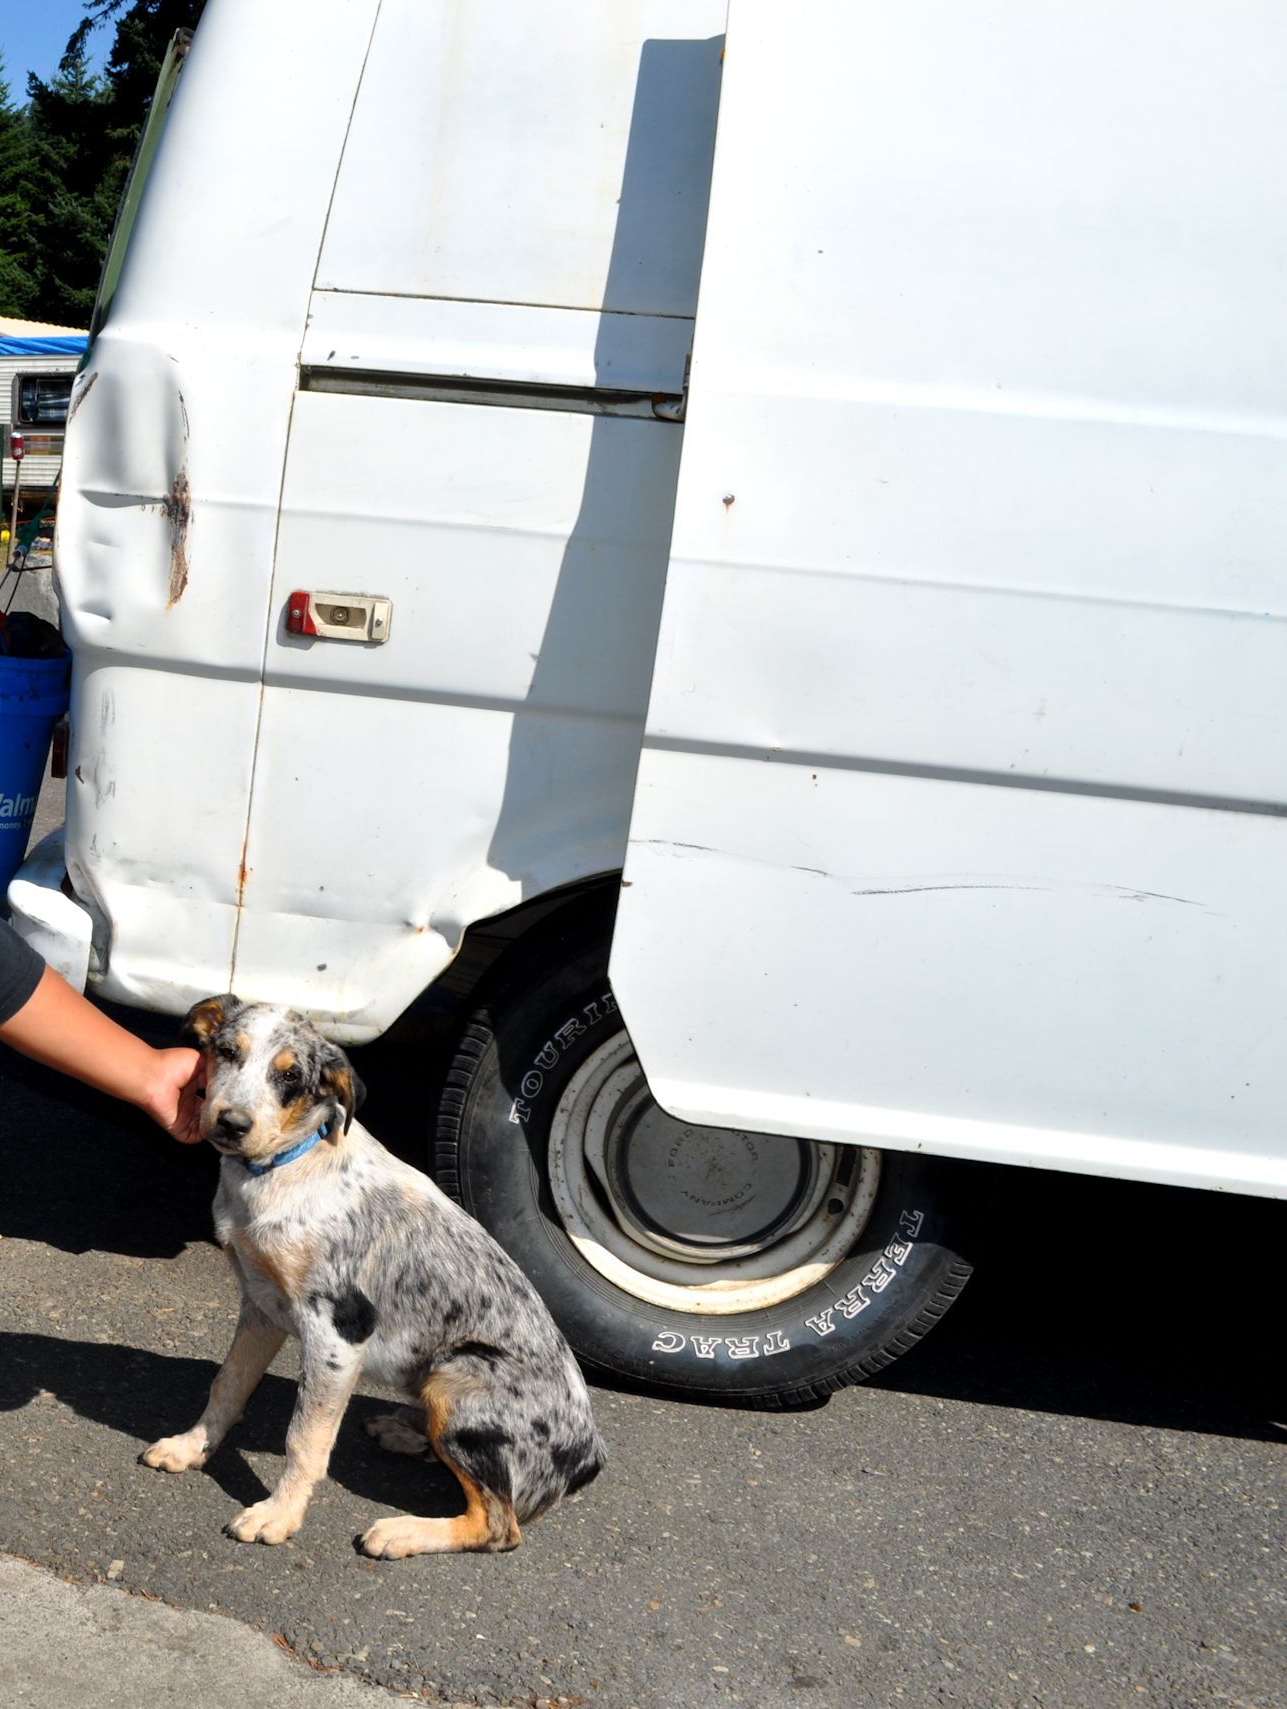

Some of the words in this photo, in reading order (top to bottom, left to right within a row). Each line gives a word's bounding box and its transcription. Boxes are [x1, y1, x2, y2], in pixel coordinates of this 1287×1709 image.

[680, 1183, 753, 1206] COMPANY
[805, 1210, 925, 1336] TERRA
[652, 1330, 791, 1359] TRAC
